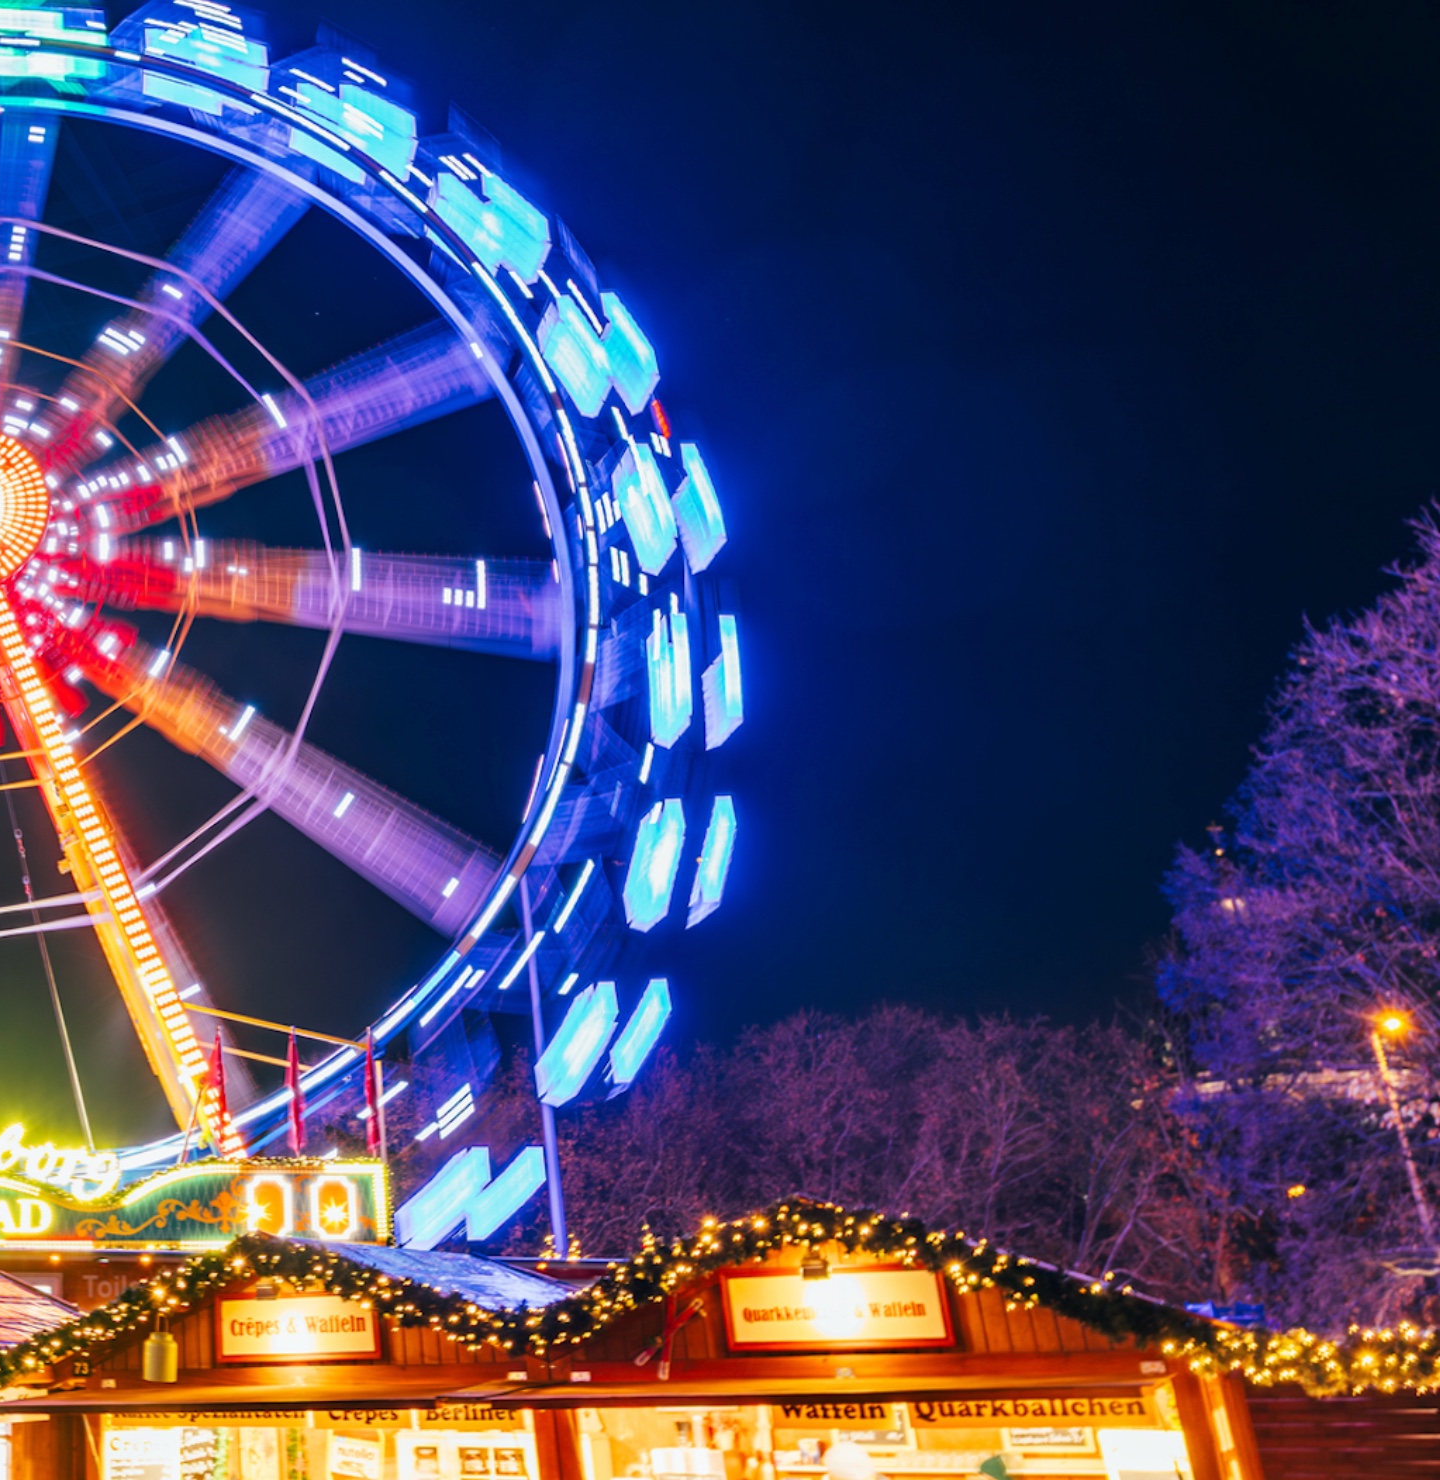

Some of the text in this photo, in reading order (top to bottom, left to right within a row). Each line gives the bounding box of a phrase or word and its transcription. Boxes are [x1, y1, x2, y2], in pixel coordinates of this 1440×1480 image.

[869, 1301, 927, 1318] Waffeln
[230, 1316, 280, 1338] Crêpes
[304, 1314, 367, 1334] Waffeln
[73, 1362, 89, 1375] 73
[781, 1403, 886, 1419] Waffeln
